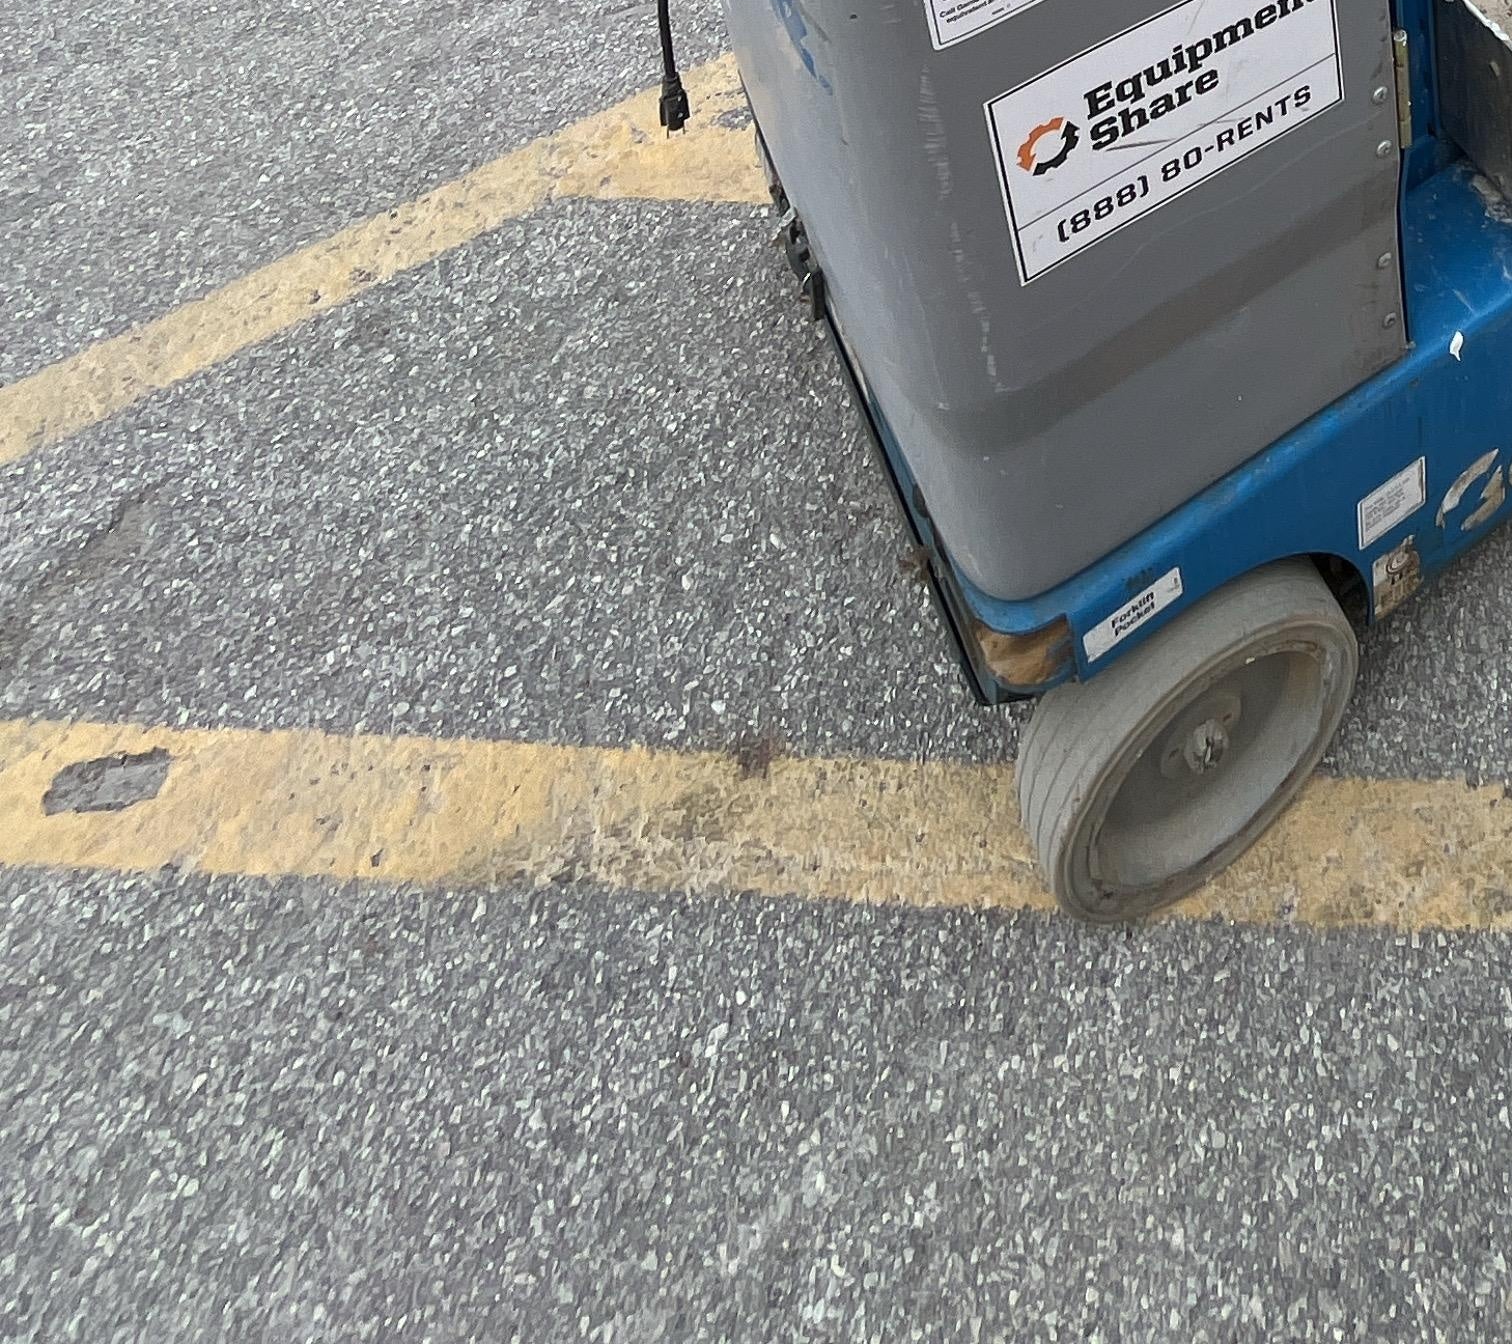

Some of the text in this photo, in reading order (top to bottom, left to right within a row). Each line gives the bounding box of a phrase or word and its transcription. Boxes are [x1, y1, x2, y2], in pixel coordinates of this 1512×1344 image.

[1058, 85, 1312, 242] (888) 80-RENTS
[1090, 68, 1219, 151] Share
